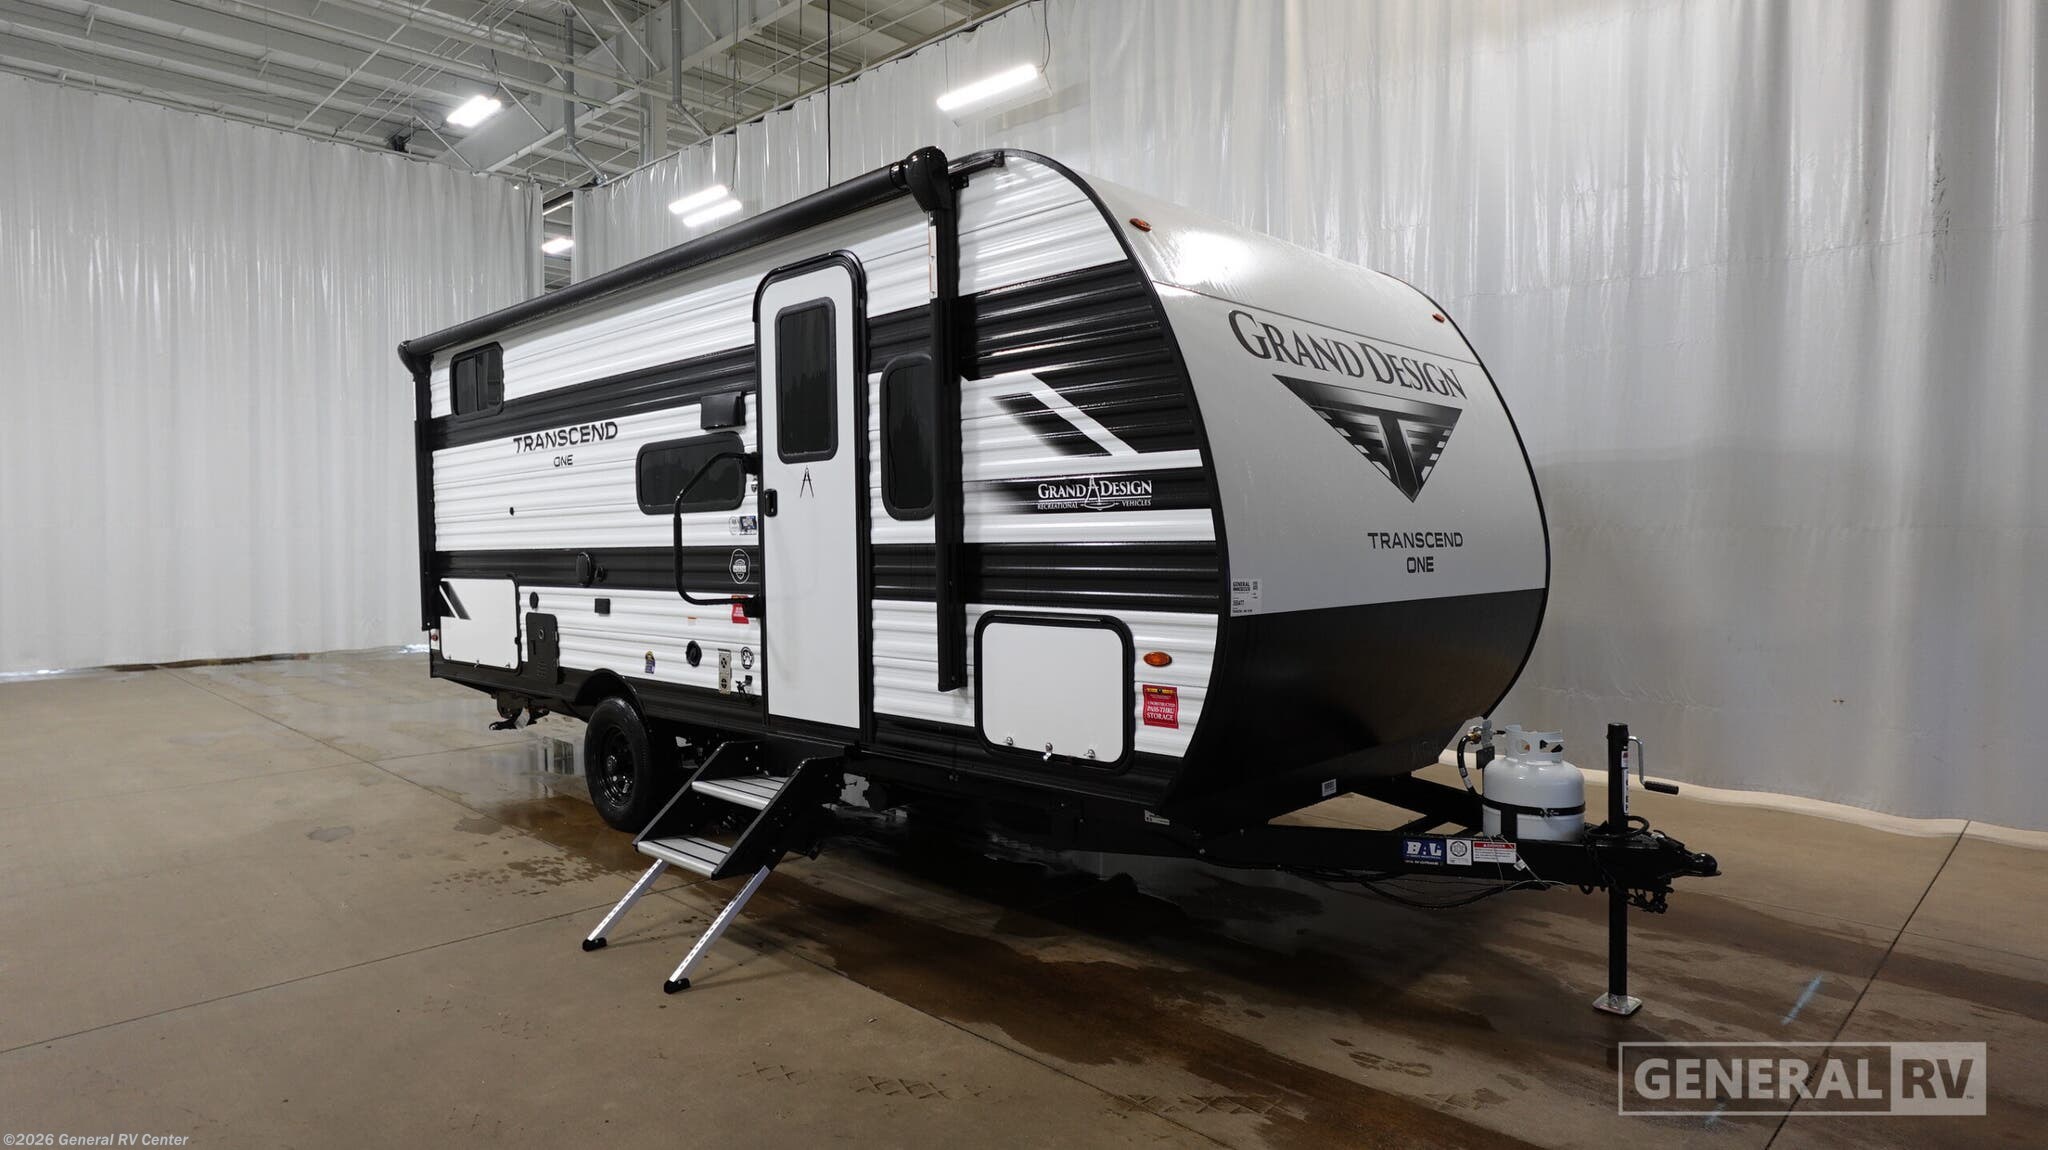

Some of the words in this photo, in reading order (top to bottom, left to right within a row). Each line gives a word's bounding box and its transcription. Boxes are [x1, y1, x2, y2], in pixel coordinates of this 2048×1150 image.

[1228, 309, 1364, 378] GRAND
[1355, 340, 1467, 400] DESIGN
[513, 421, 618, 454] TRANSCEND
[553, 454, 574, 468] ONE
[1038, 483, 1087, 499] GRAND
[1099, 480, 1153, 497] DESIGN
[1037, 501, 1078, 510] RECREATIONAL
[1121, 498, 1152, 507] VEHICLES
[1367, 531, 1463, 550] TRANSCEND
[1406, 555, 1435, 574] ONE
